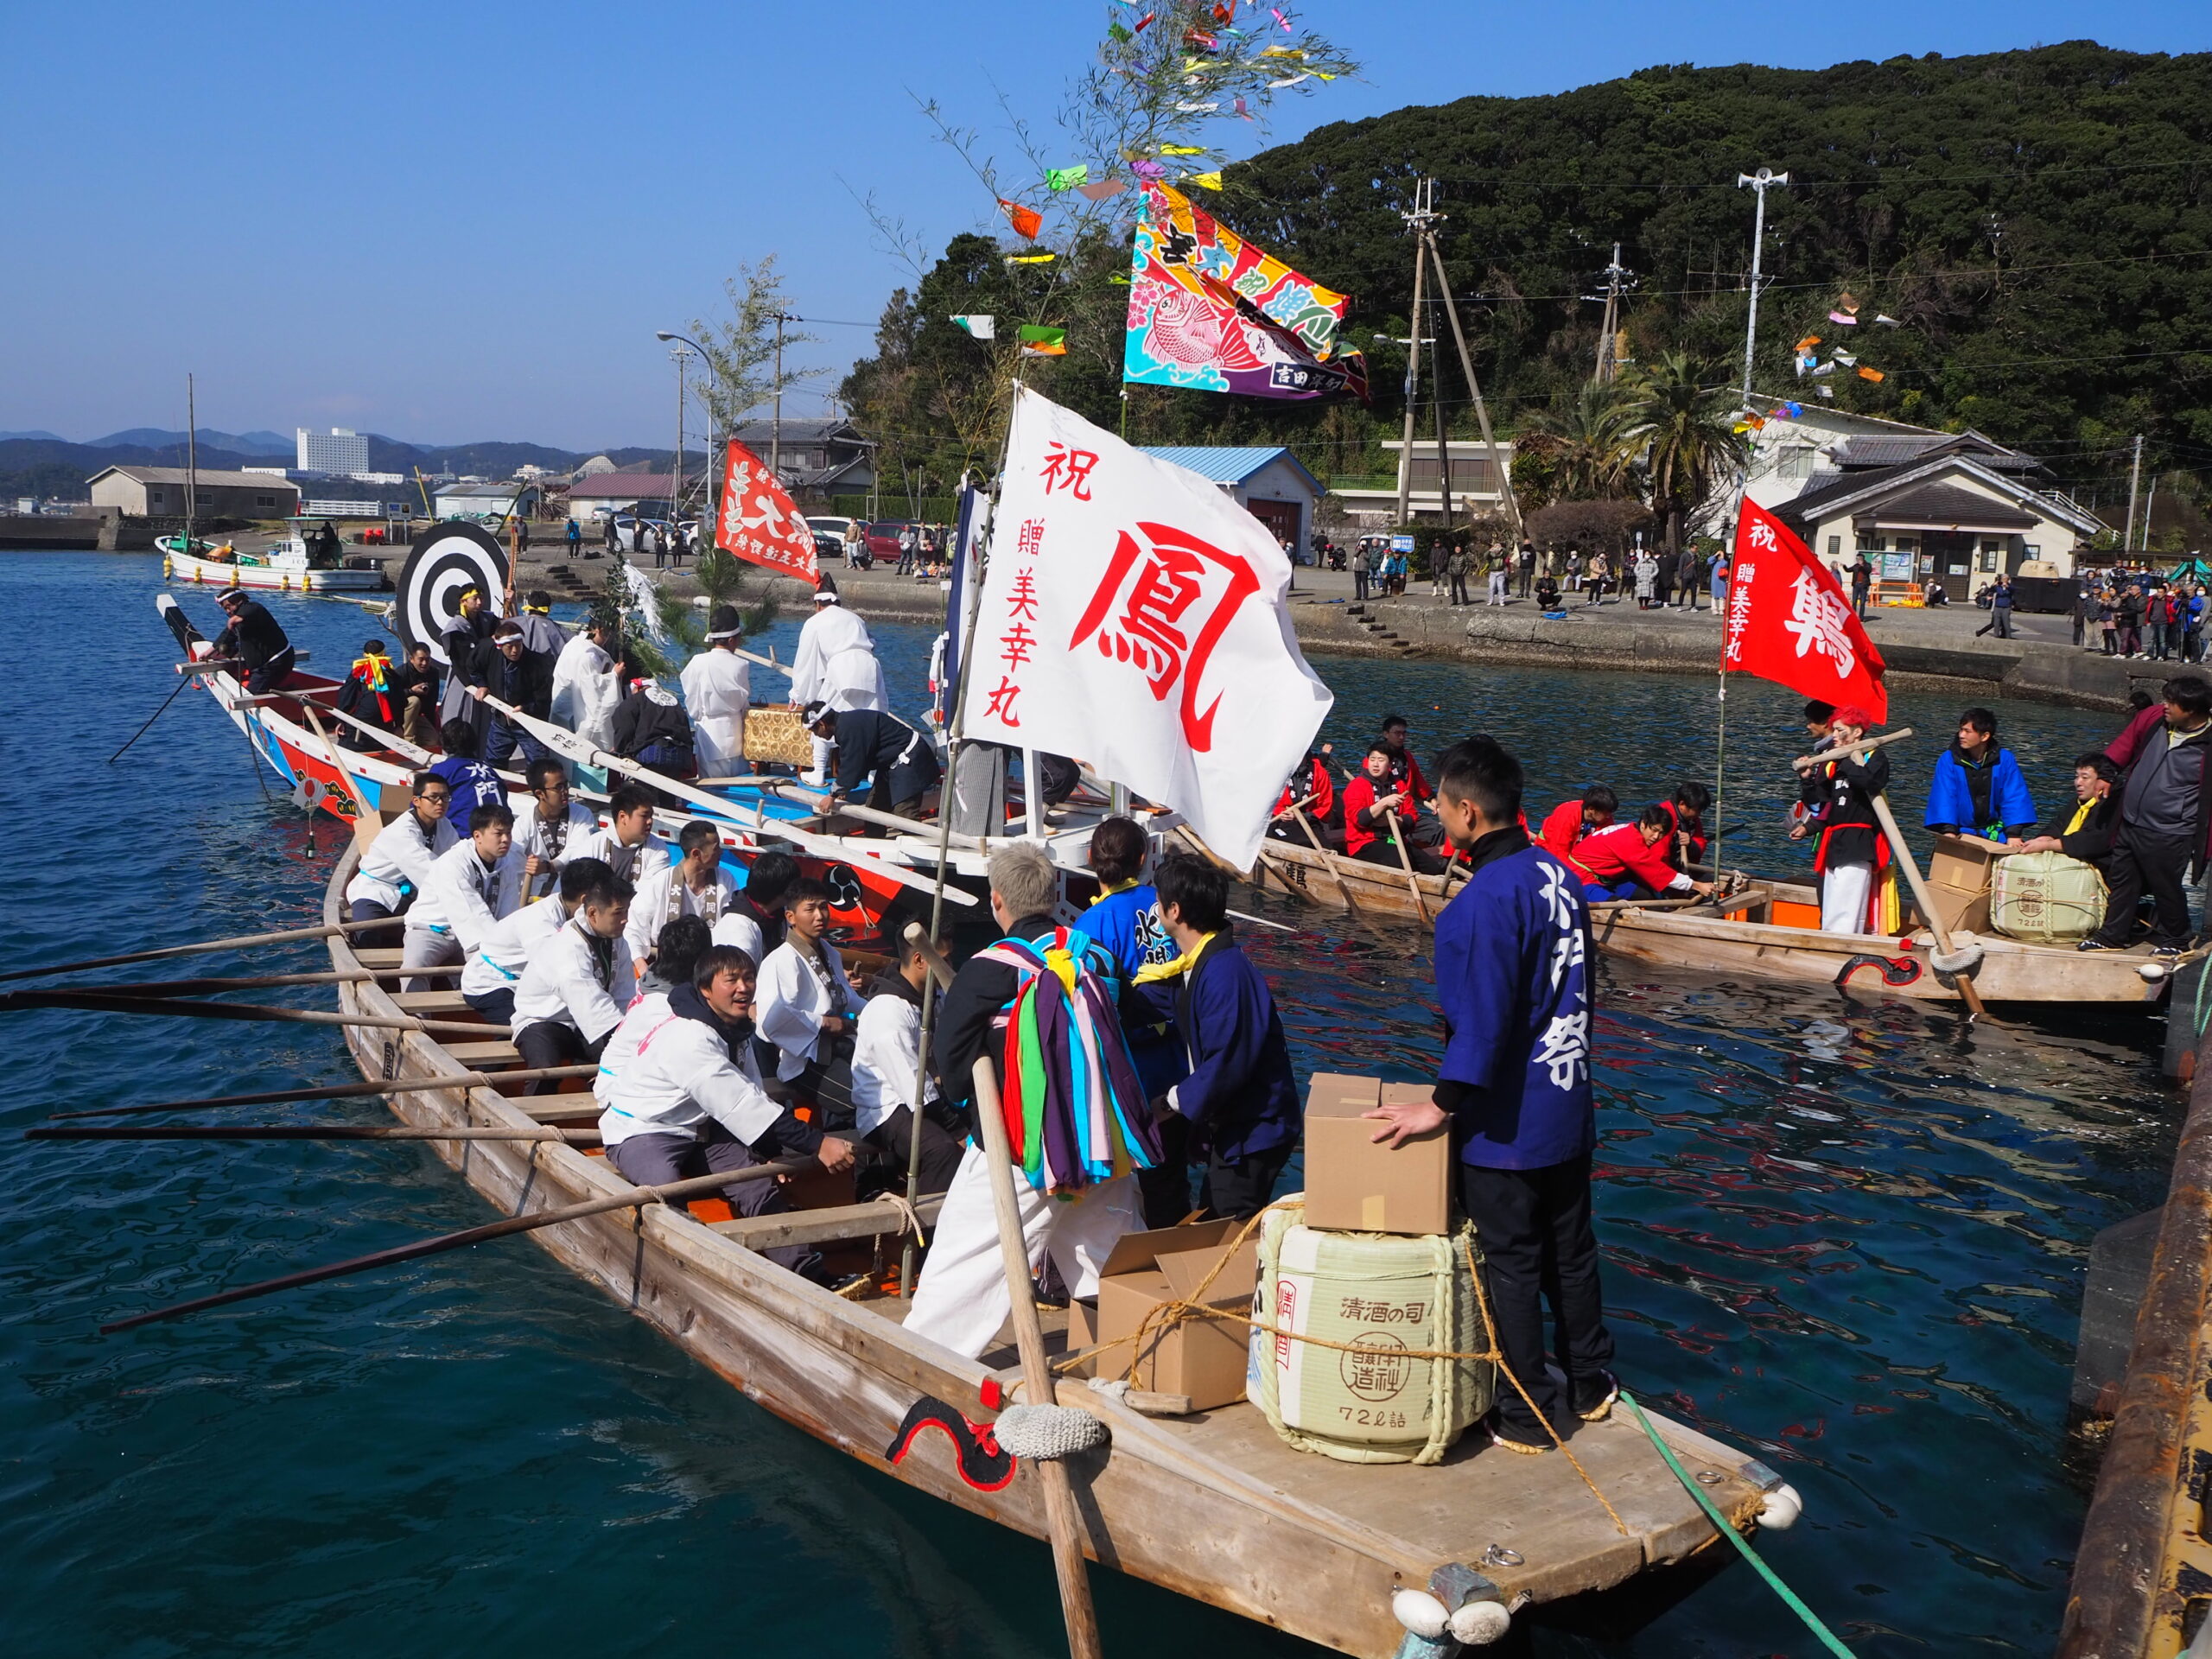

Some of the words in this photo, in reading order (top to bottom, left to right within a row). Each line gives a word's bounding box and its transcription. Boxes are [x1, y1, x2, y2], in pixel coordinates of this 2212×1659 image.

[1039, 441, 1100, 502] 祝
[1748, 518, 1777, 553] 祝
[1068, 520, 1261, 753] 鳳
[1533, 861, 1588, 1091] 水門祭
[1340, 1297, 1425, 1324] 清酒の司
